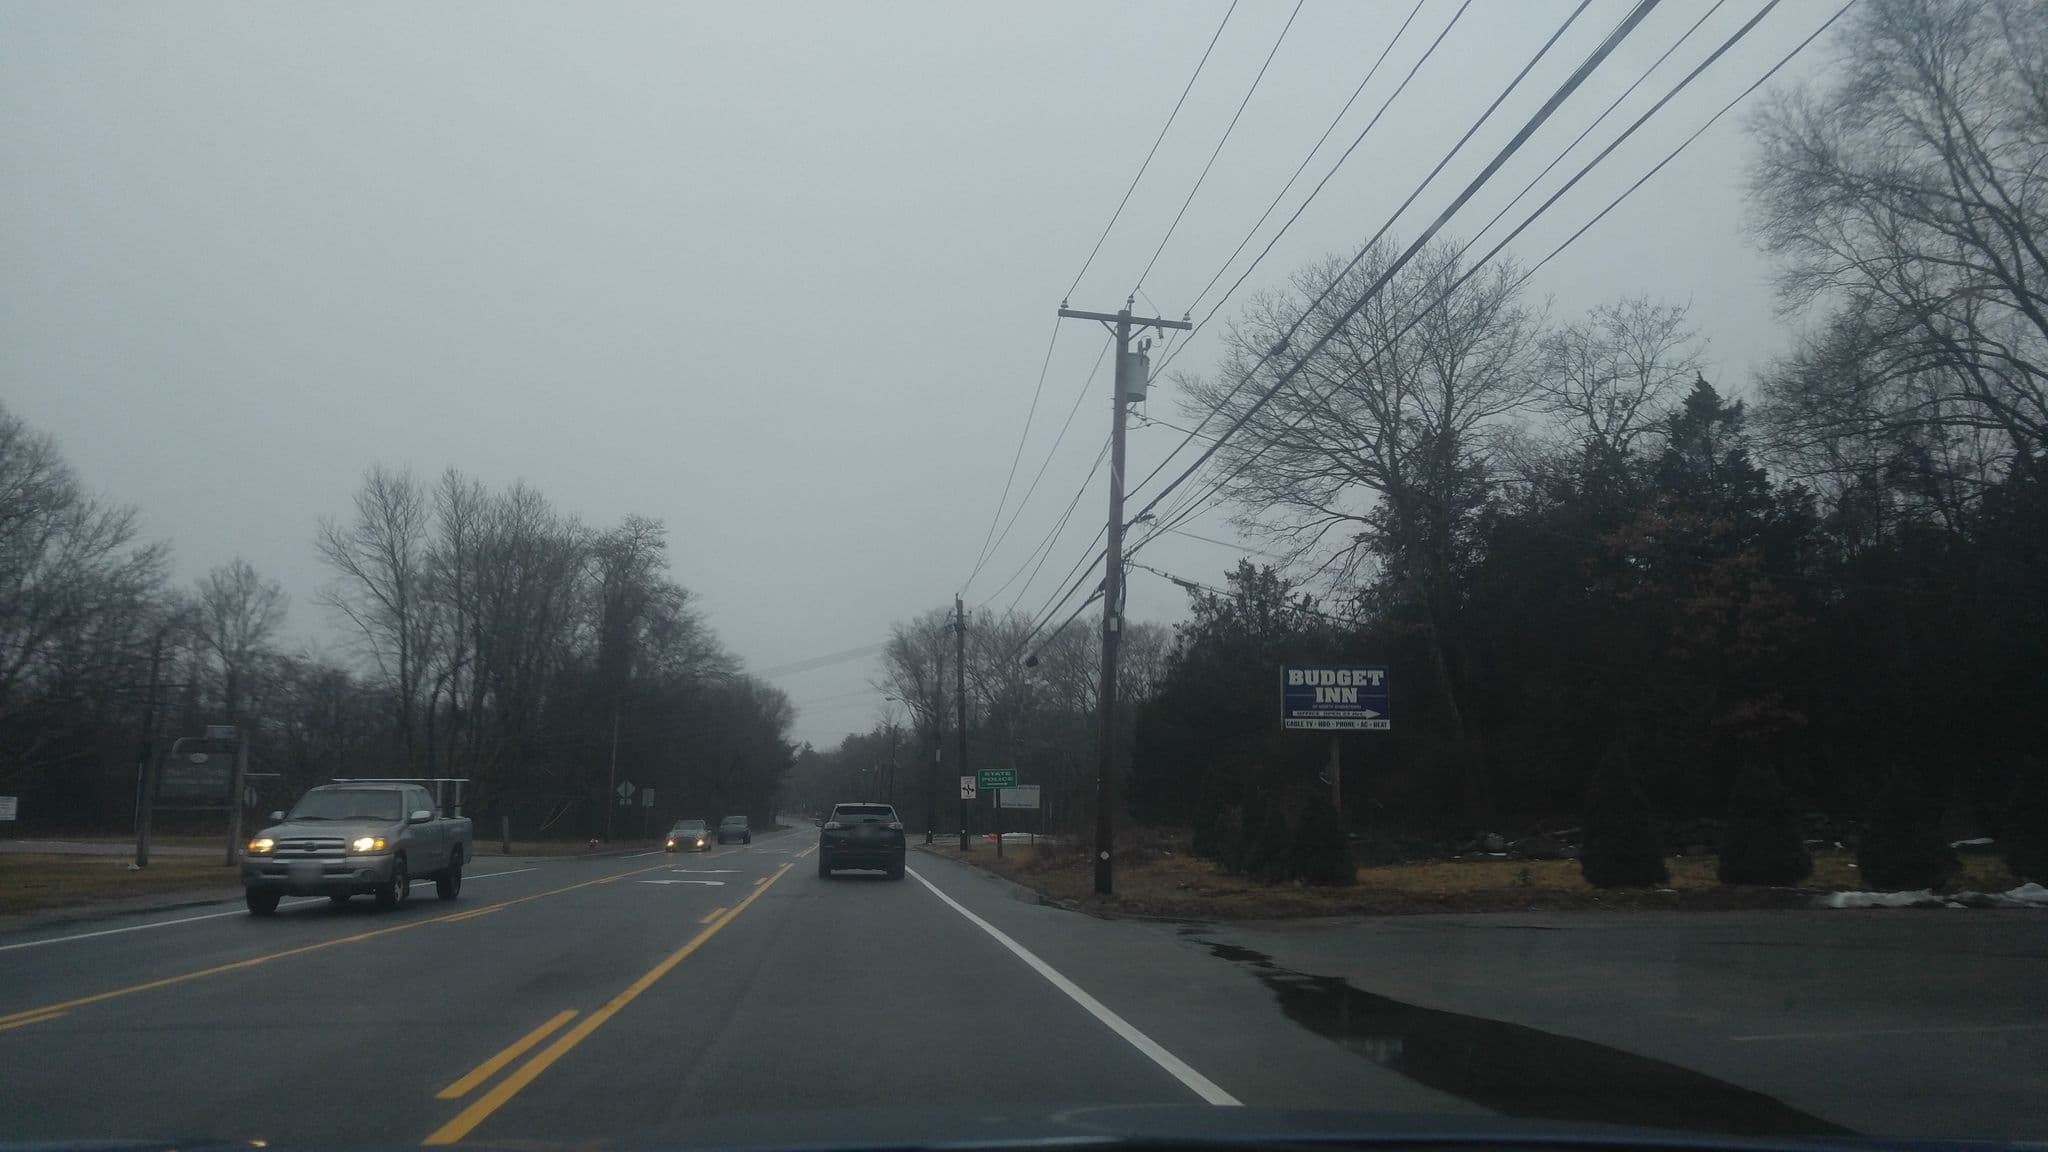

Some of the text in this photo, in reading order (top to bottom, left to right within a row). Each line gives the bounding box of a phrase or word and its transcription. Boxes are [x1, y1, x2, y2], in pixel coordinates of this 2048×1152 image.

[1288, 669, 1384, 686] BUDGET
[1315, 687, 1358, 703] INN
[1286, 720, 1304, 728] CABLE
[1306, 720, 1313, 728] TV
[1335, 720, 1355, 729] PHONE
[1360, 721, 1369, 729] AC
[1373, 721, 1388, 729] HEAT
